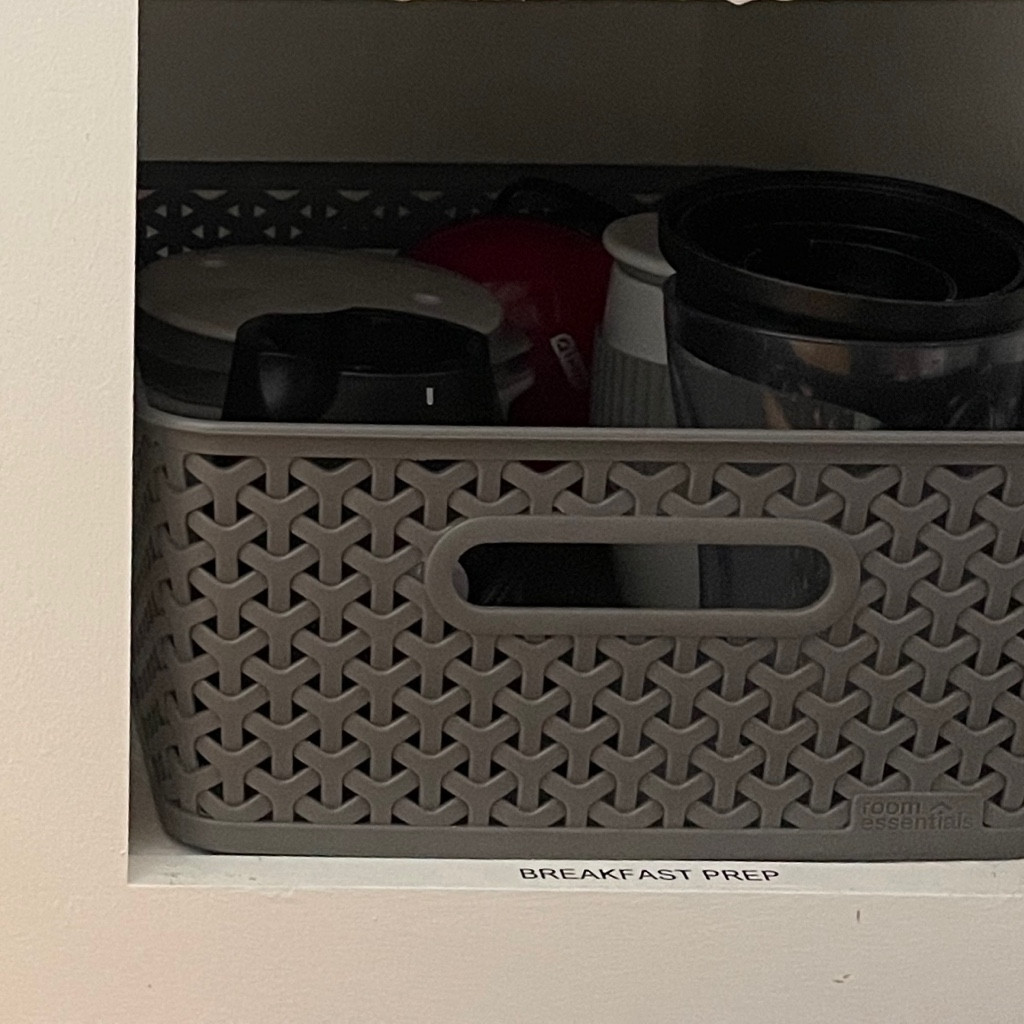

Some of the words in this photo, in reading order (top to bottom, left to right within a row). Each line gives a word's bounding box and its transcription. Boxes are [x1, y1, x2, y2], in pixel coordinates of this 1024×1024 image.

[862, 800, 921, 815] room
[862, 811, 974, 830] essentials
[519, 868, 693, 881] BREAKFAST
[702, 869, 780, 882] PREP
